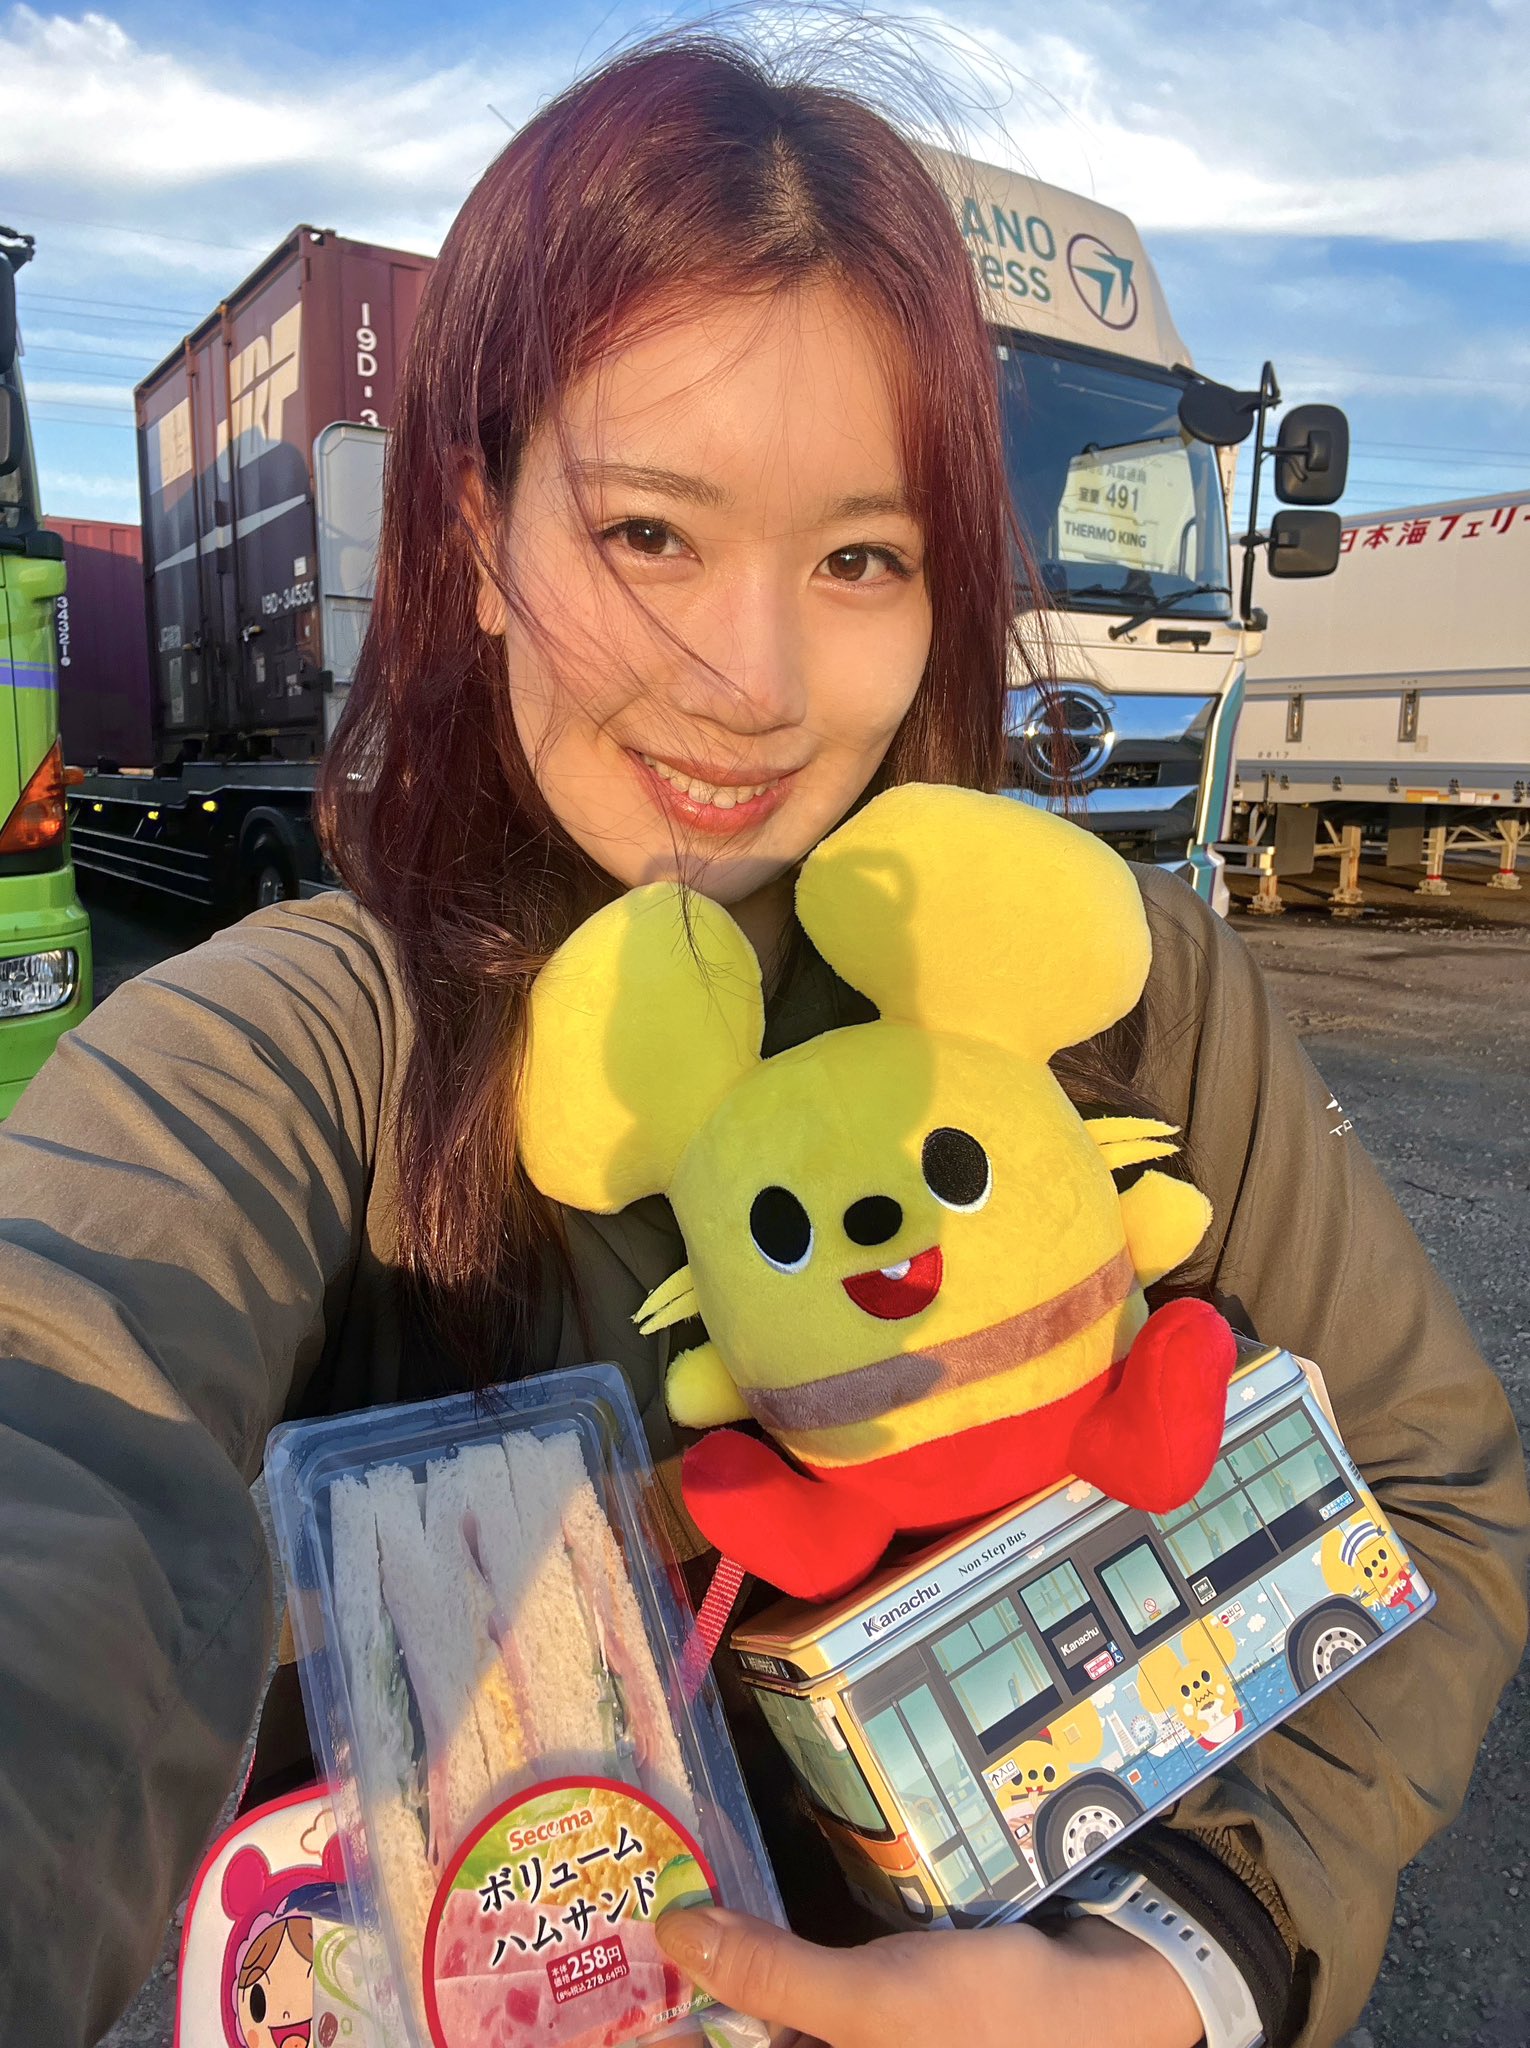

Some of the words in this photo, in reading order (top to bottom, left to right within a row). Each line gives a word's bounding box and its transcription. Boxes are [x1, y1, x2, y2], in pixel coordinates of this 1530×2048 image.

[974, 250, 1053, 304] ess
[1105, 482, 1139, 512] 491
[1063, 520, 1117, 543] THERMO
[1118, 530, 1147, 549] KING
[1340, 506, 1530, 554] 日本海フェリ
[957, 1560, 982, 1577] Non
[981, 1543, 1007, 1563] Step
[1006, 1529, 1028, 1548] Bus
[862, 1582, 942, 1638] Kanachu
[1226, 1603, 1242, 1618] 出口
[1060, 1626, 1100, 1657] Kanachu
[998, 1760, 1016, 1778] 入口
[508, 1808, 594, 1852] Secoma
[478, 1826, 643, 1913] ボリューム
[491, 1870, 657, 1966] ハムサンド
[551, 1963, 568, 1977] 本体
[553, 1974, 571, 1988] 価格
[567, 1944, 623, 1981] 258円
